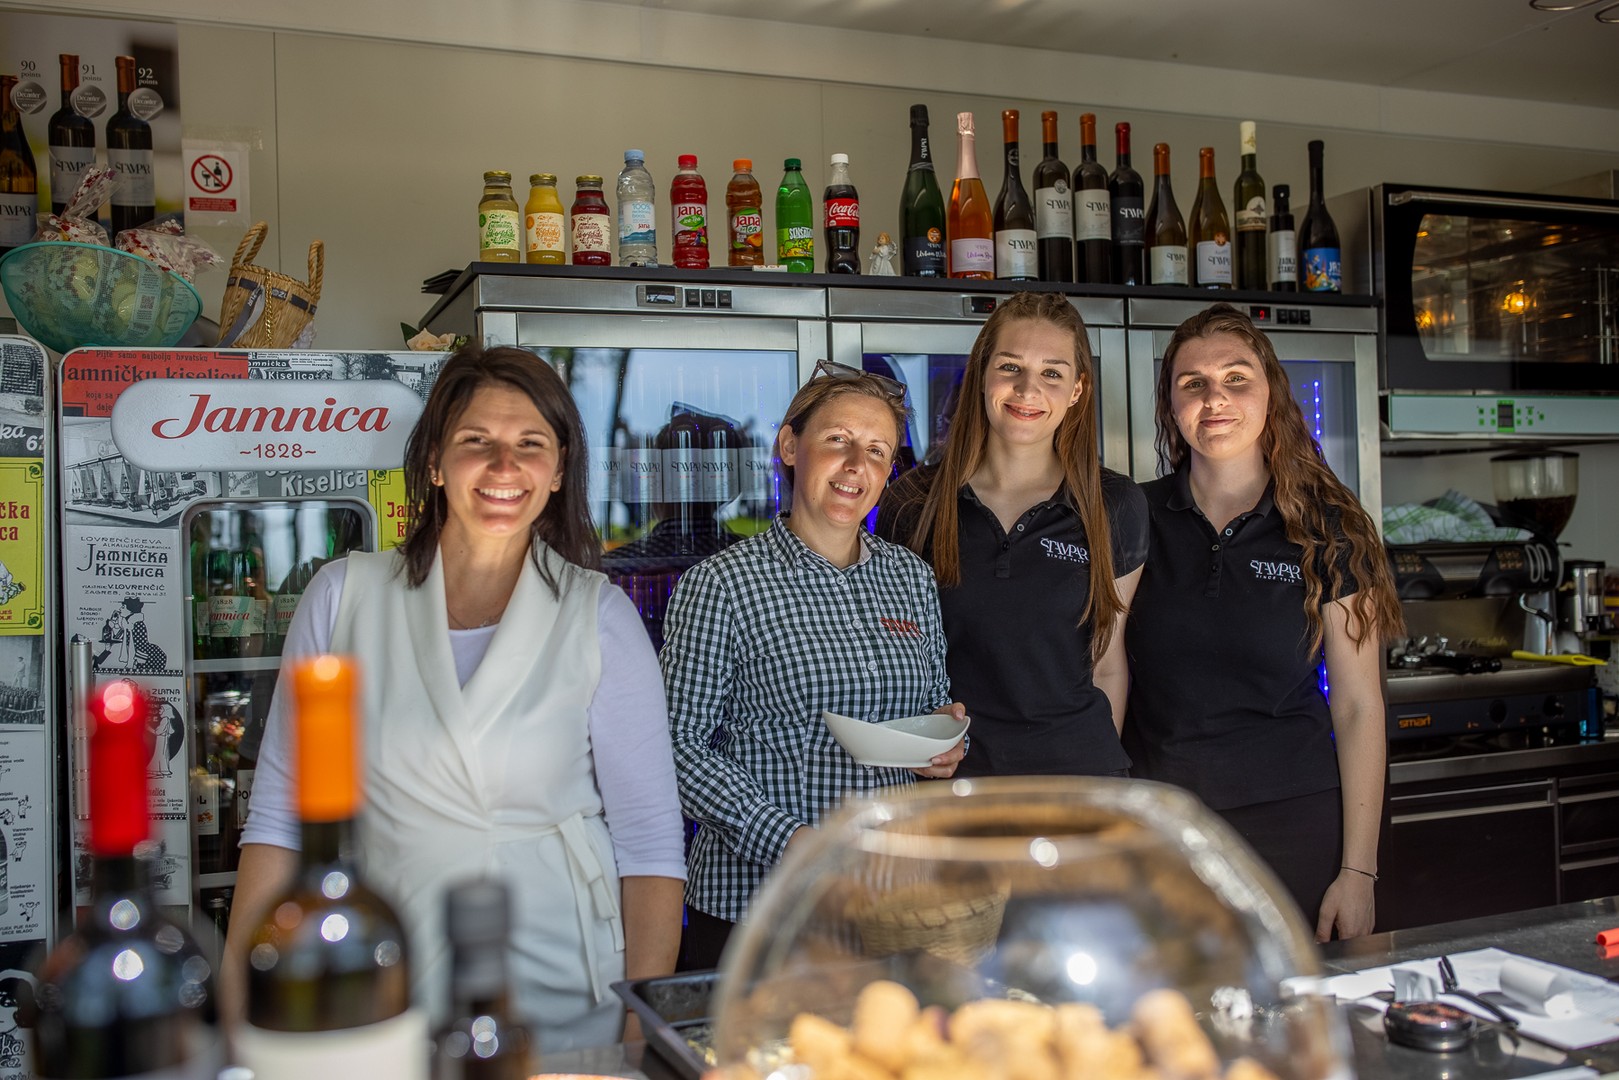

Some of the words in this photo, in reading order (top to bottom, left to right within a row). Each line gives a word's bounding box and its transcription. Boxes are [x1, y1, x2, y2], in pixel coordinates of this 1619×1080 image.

[20, 60, 36, 72] 90
[82, 64, 96, 75] 91
[21, 71, 41, 79] points
[82, 74, 102, 82] points
[138, 67, 154, 79] 92
[138, 78, 158, 86] points
[677, 206, 703, 218] Jana
[735, 215, 761, 227] Jana
[63, 365, 156, 383] amničku
[151, 393, 392, 439] Jamnica
[281, 469, 367, 498] Kiselica
[76, 543, 168, 572] JAMNIČKA
[95, 563, 165, 578] KISELICA
[210, 610, 250, 621] amnica
[1398, 715, 1432, 729] smart
